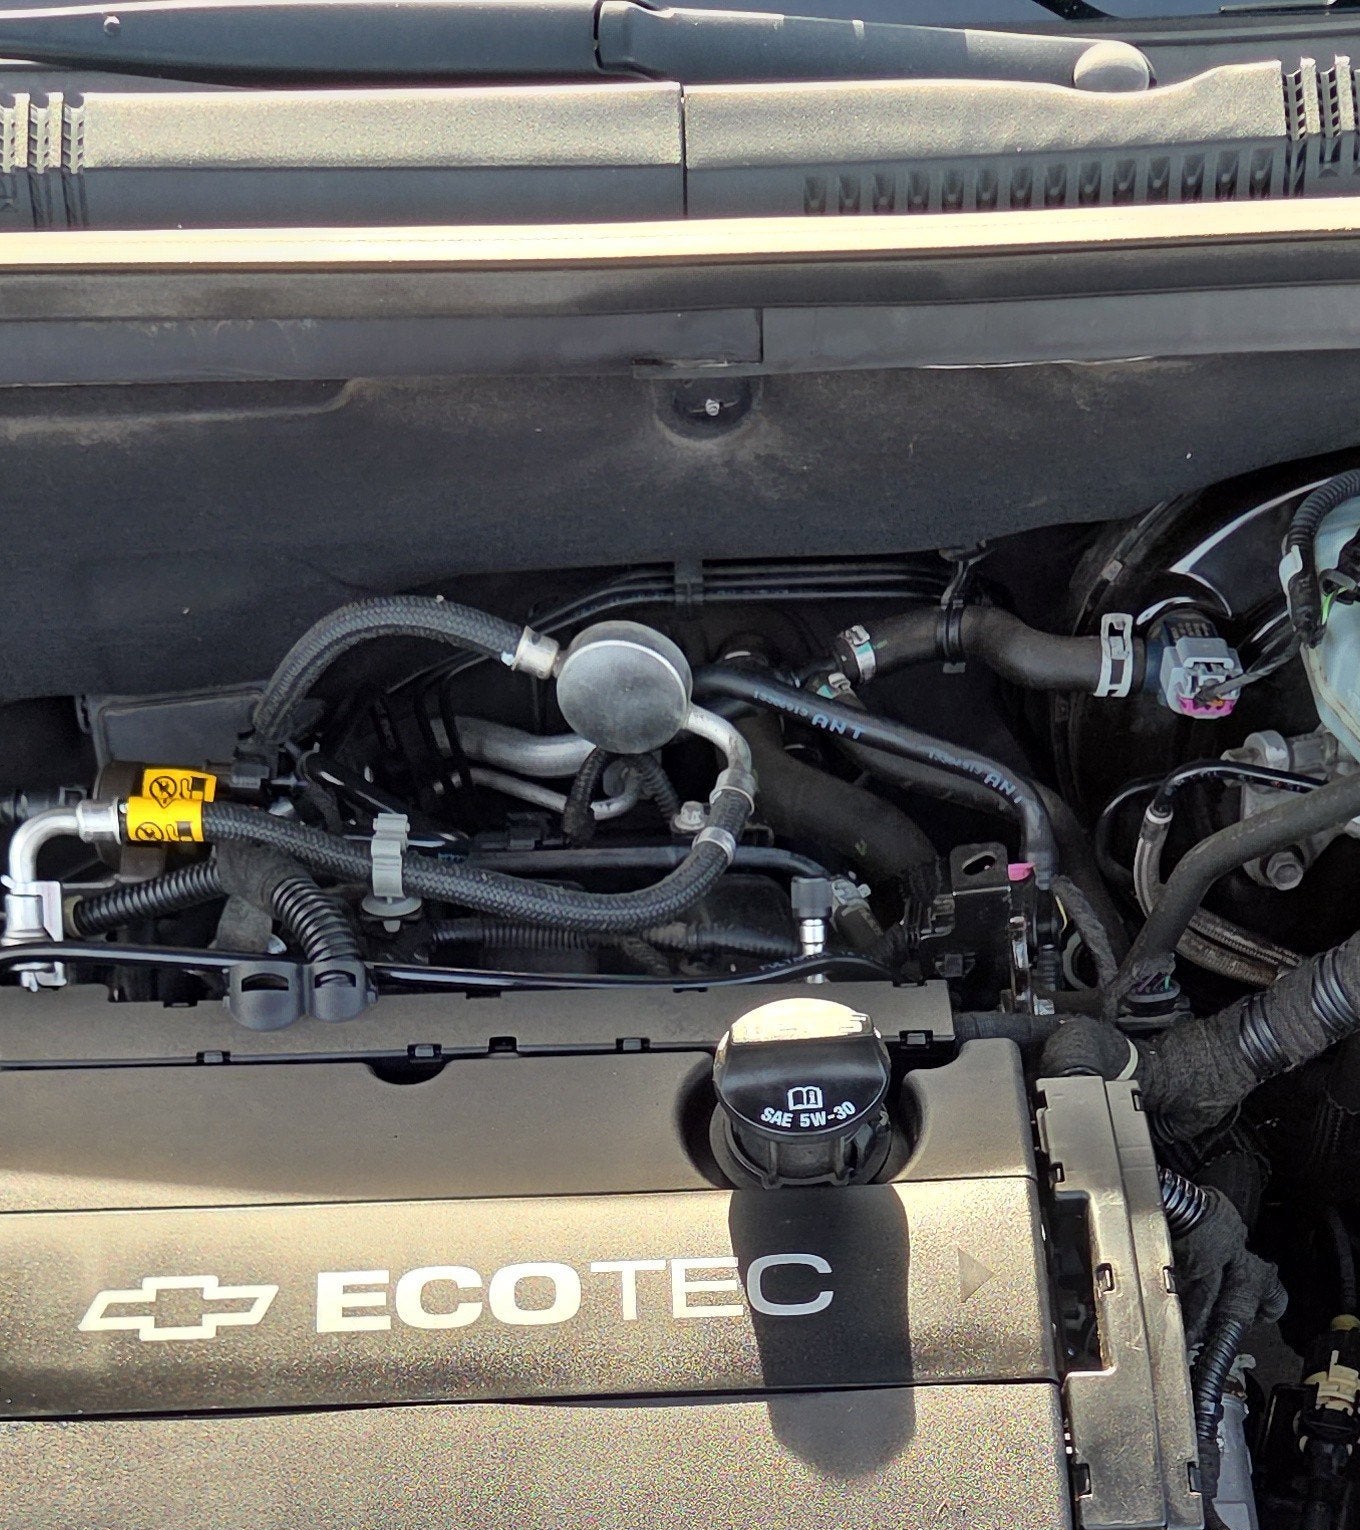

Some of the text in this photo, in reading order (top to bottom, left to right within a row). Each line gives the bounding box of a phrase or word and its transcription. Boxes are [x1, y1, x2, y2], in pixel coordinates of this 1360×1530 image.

[761, 1101, 856, 1127] SAE 5W-30
[316, 1252, 835, 1335] ECOTEC
